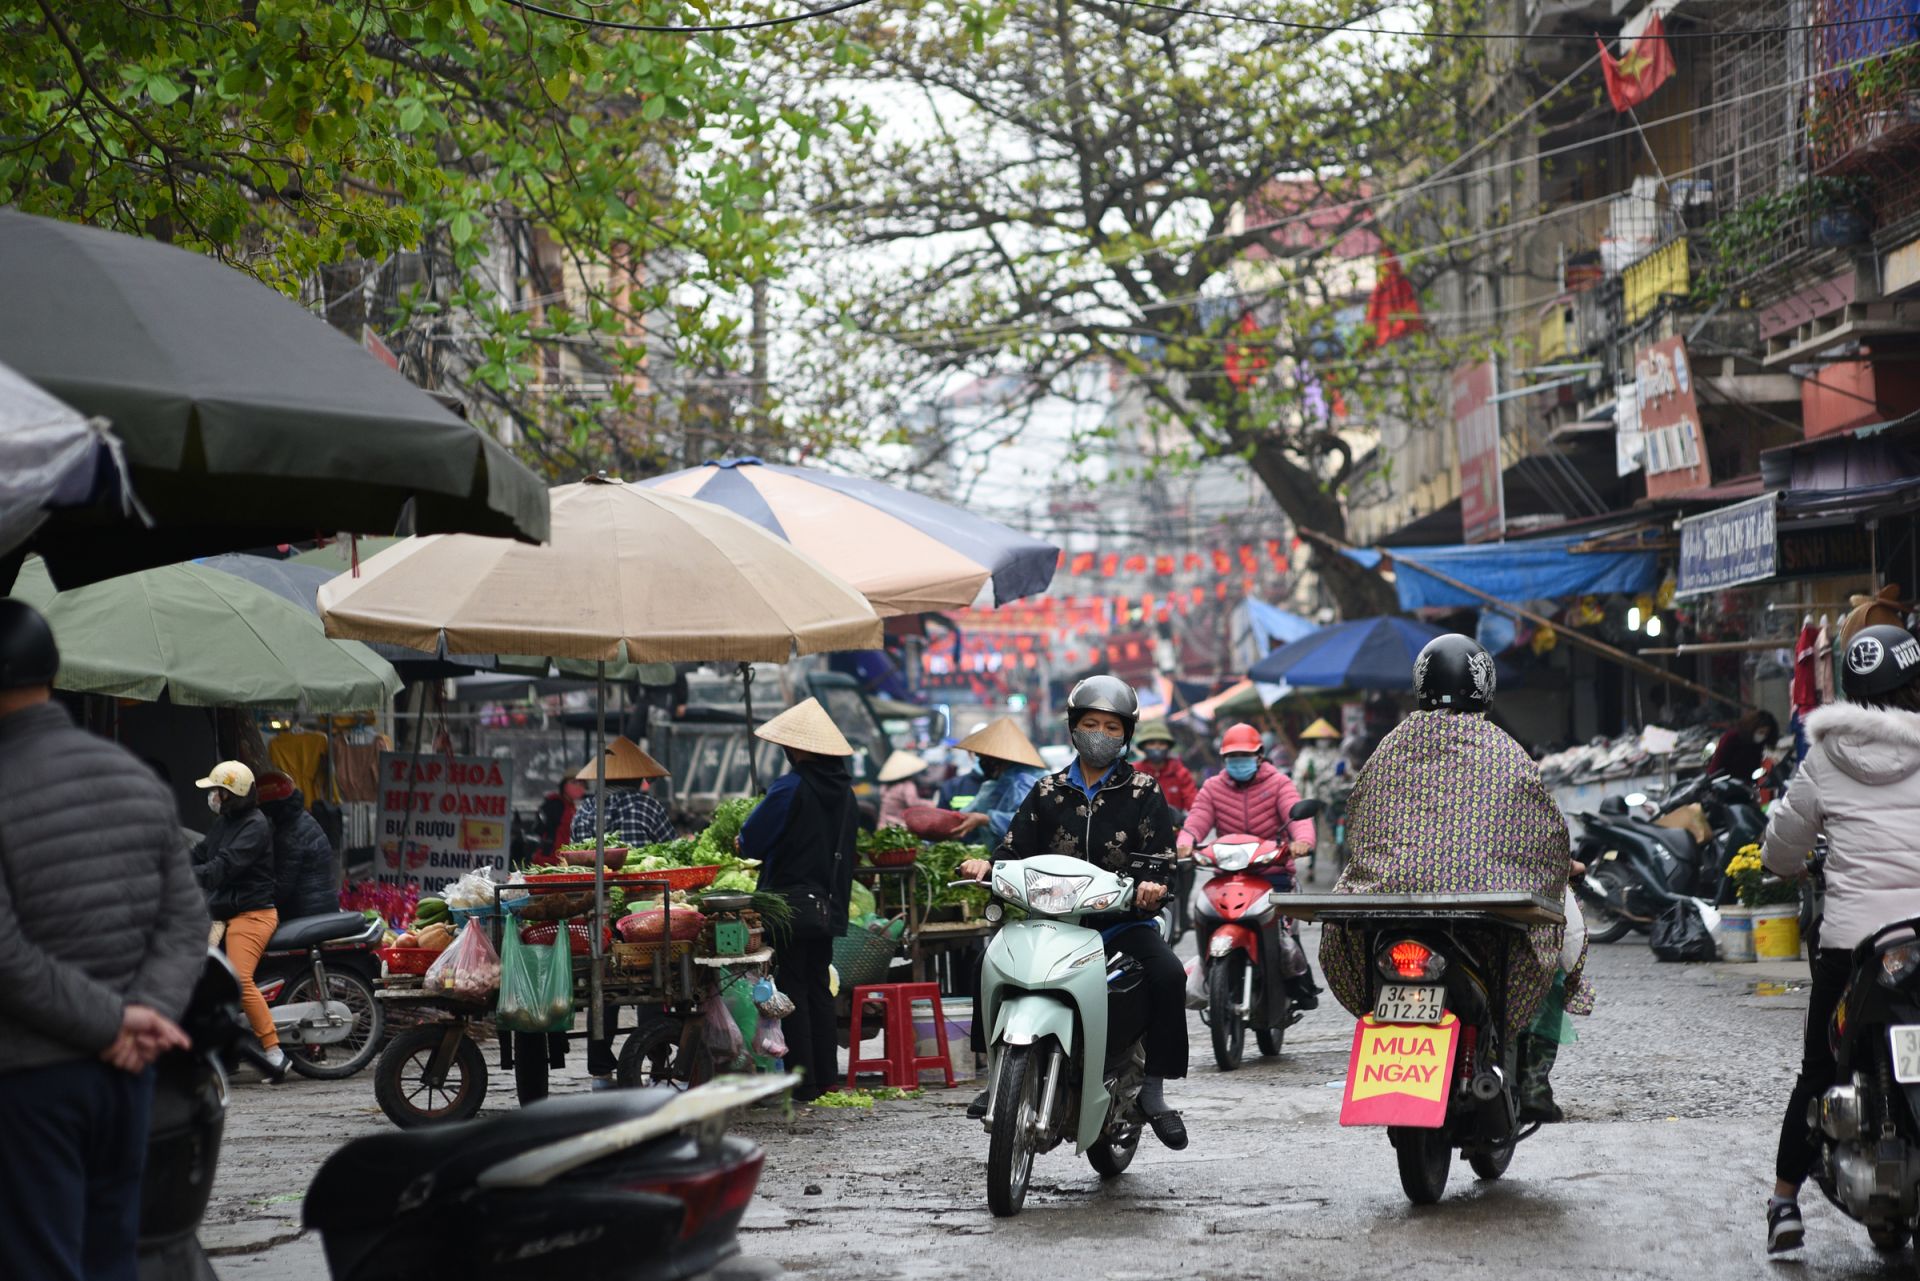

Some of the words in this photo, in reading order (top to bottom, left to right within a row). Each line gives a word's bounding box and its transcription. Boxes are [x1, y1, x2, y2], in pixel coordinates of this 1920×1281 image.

[1894, 643, 1920, 670] HUL
[385, 790, 435, 812] HUY
[441, 794, 507, 816] OANH
[1032, 923, 1057, 931] HONDA
[1387, 986, 1436, 1003] 34-C1
[1377, 1003, 1440, 1020] 012.25
[1372, 1036, 1436, 1056] MUA
[1363, 1064, 1439, 1083] NGAY
